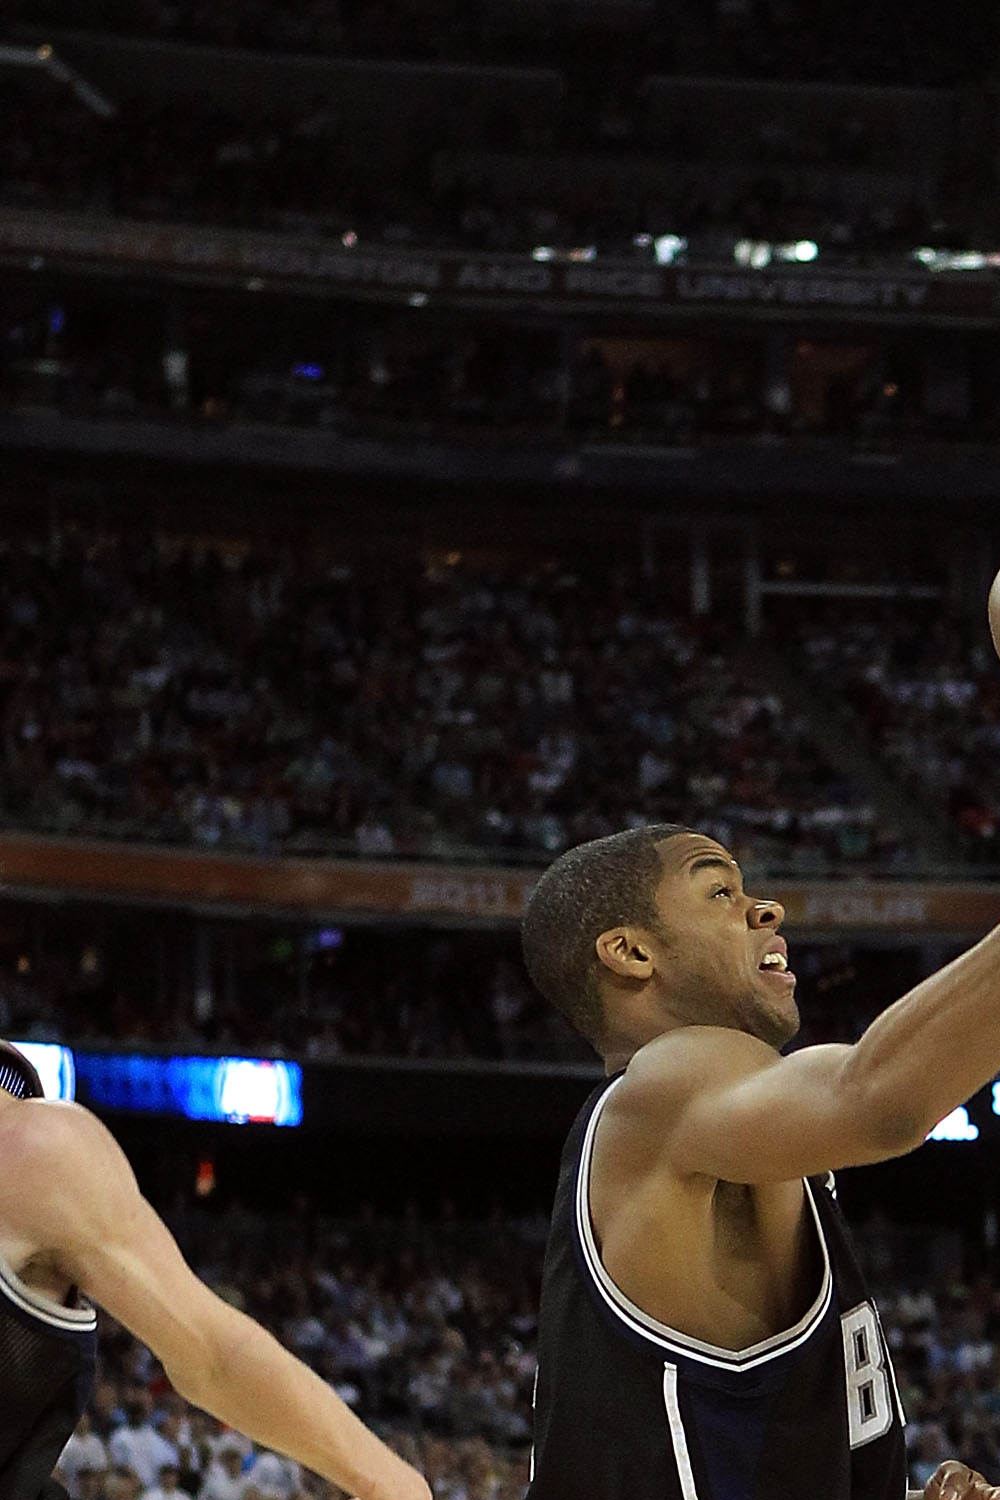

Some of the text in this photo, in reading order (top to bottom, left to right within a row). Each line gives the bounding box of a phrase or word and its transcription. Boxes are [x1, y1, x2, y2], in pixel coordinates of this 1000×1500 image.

[456, 263, 551, 292] AND
[565, 267, 663, 297] RICE
[675, 270, 928, 306] UNIVERSITY
[840, 1297, 907, 1451] B
